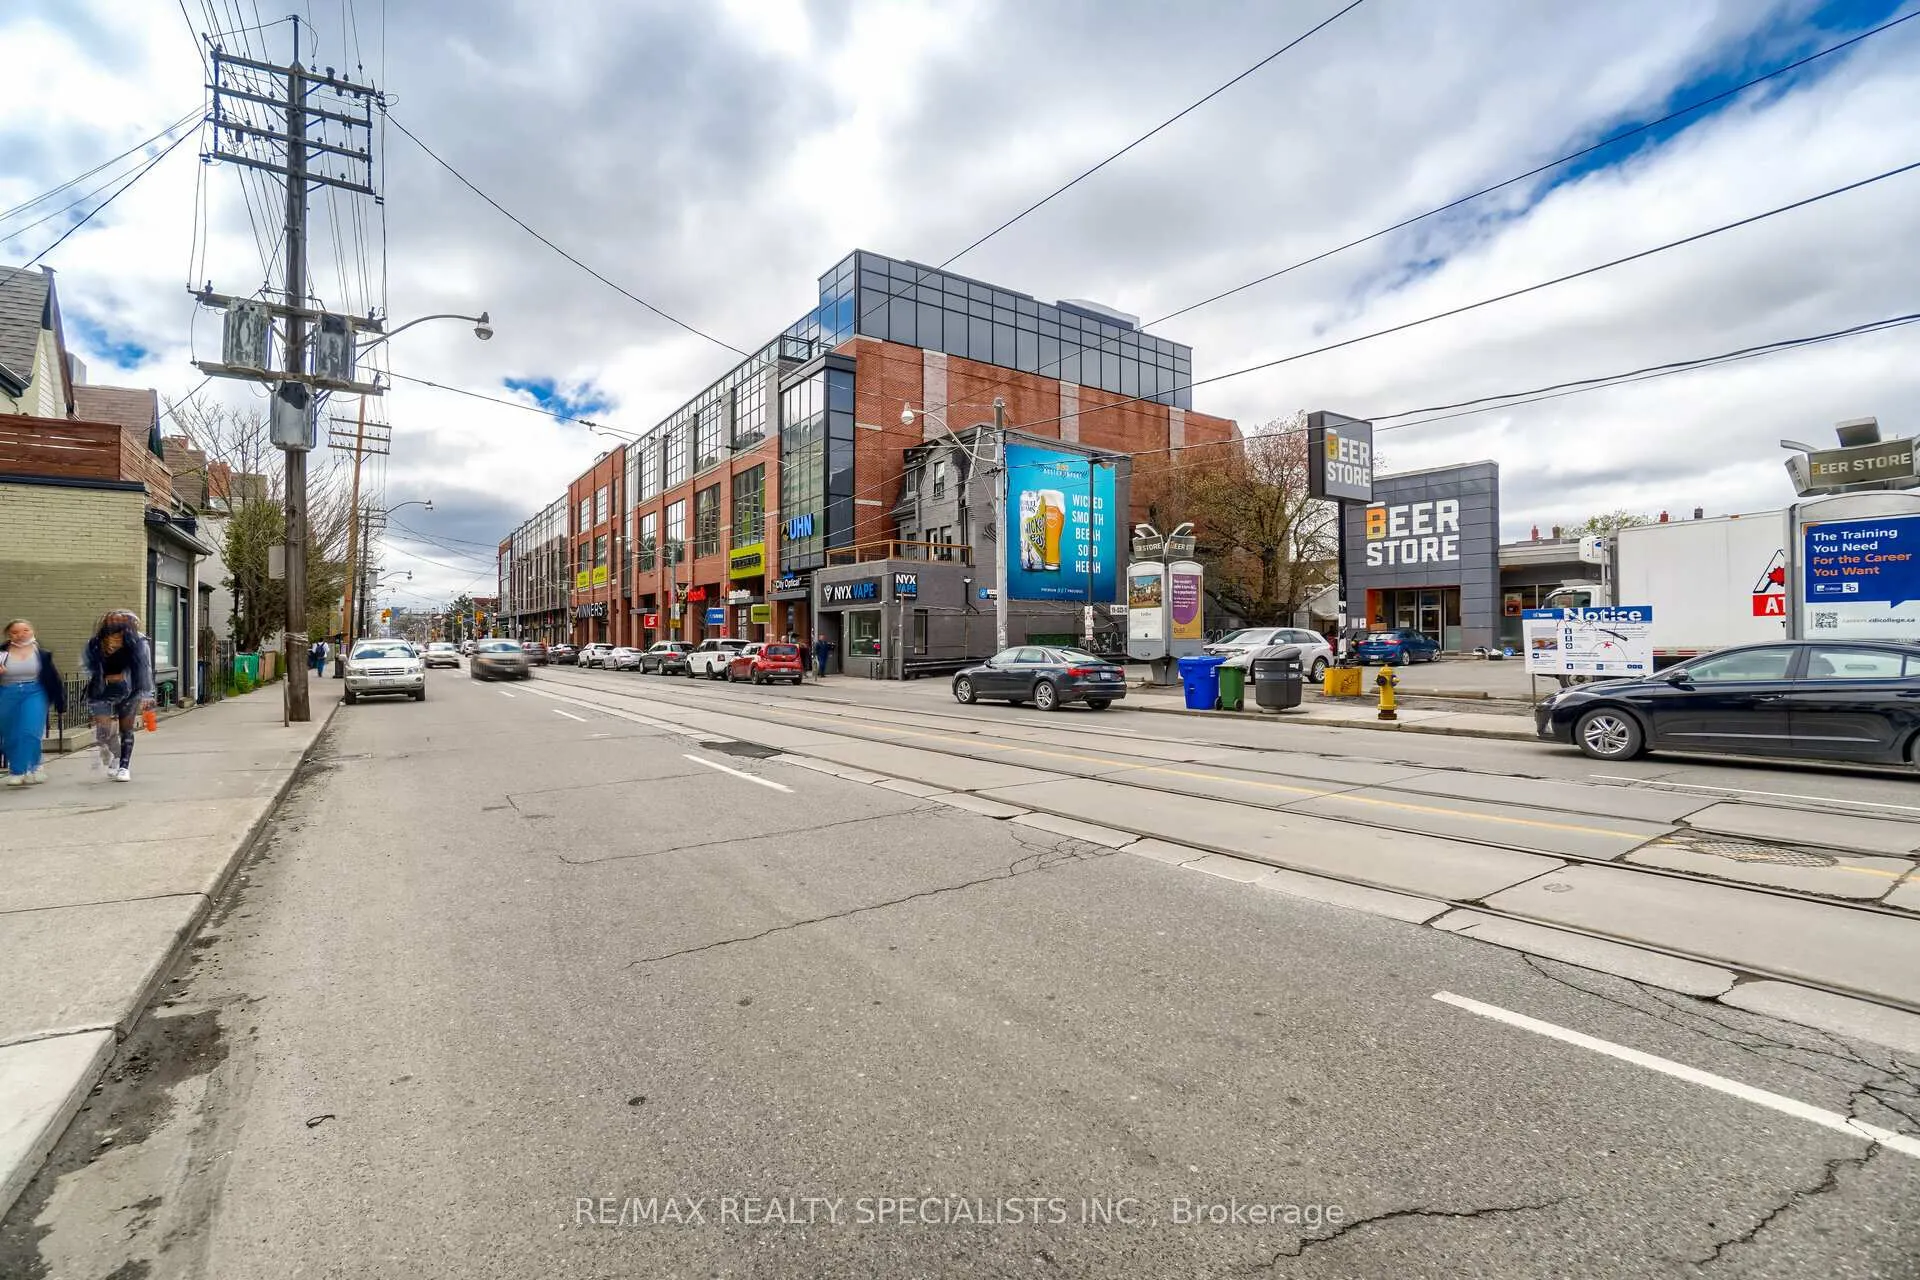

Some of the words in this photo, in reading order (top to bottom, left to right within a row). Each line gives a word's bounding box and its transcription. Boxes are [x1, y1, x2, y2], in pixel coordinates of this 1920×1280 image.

[1327, 430, 1370, 467] BEER
[1811, 462, 1848, 475] BEER
[1853, 453, 1912, 471] STORE
[1327, 461, 1370, 488] STORE
[1072, 494, 1103, 509] WICED
[1072, 510, 1104, 526] SMOTH
[1366, 500, 1460, 540] BEER
[789, 513, 814, 541] UHN
[1813, 532, 1837, 542] The
[1841, 528, 1898, 539] Training
[1078, 544, 1098, 557] SOD
[1366, 535, 1460, 567] STORE
[1813, 545, 1838, 553] You
[1842, 541, 1878, 551] Need
[1813, 556, 1834, 565] For
[1839, 554, 1861, 563] the
[1864, 552, 1912, 562] Career
[1813, 568, 1838, 577] You
[1842, 566, 1880, 576] Want
[896, 574, 916, 585] NYX
[834, 585, 852, 600] NYX
[852, 583, 875, 599] VAPE
[896, 584, 916, 593] VAPE
[1564, 607, 1642, 622] Notice
